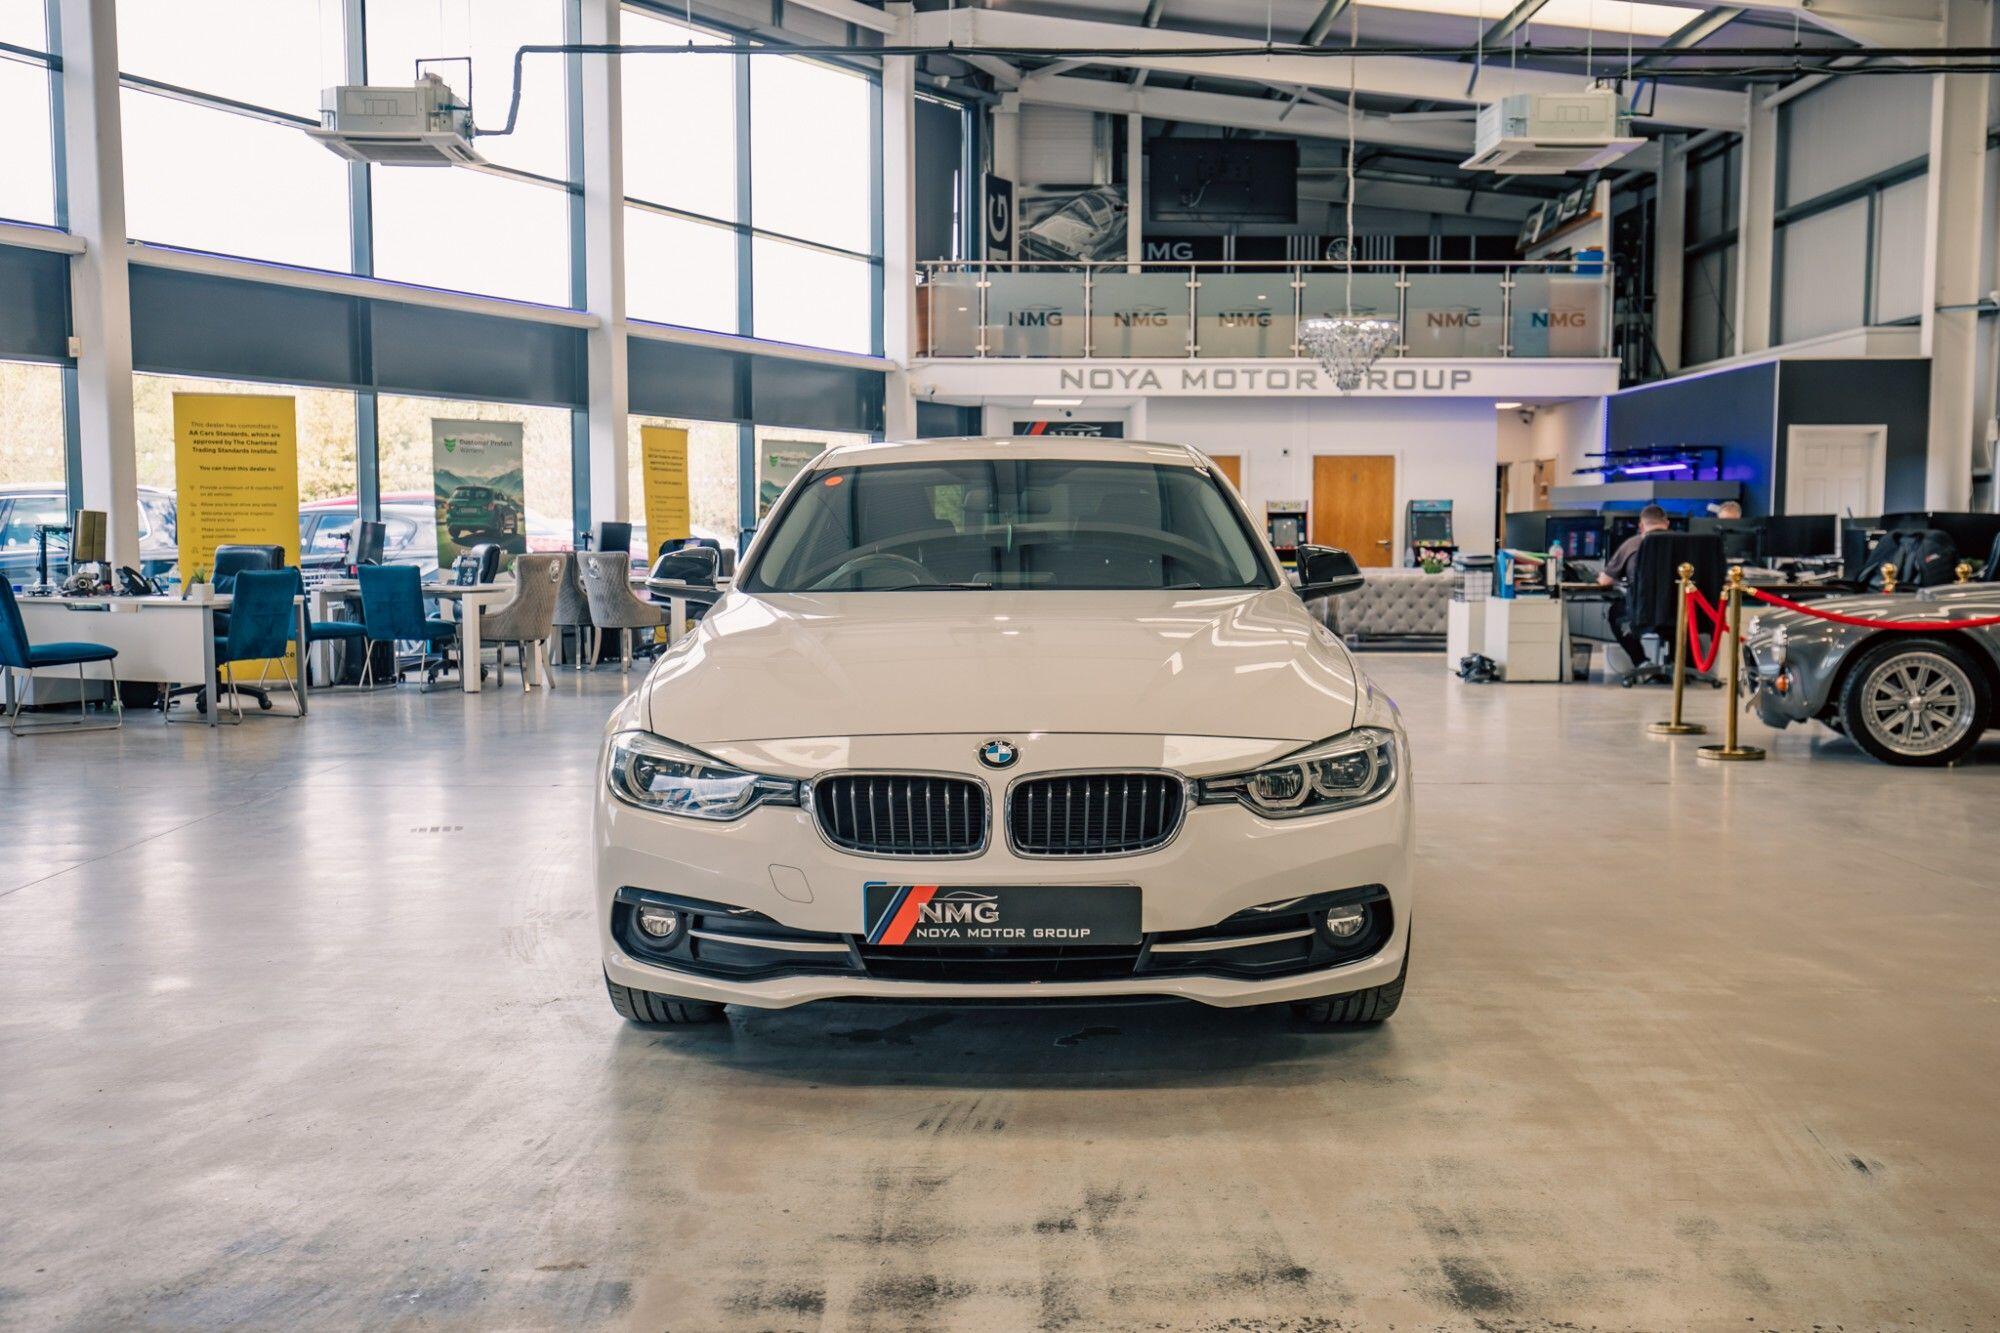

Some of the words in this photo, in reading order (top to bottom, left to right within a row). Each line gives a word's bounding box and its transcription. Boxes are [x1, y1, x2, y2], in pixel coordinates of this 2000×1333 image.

[1143, 242, 1193, 260] MG
[1008, 312, 1063, 327] NMG
[1113, 312, 1168, 327] NMG
[1218, 312, 1272, 327] NMG
[1427, 312, 1481, 327] NMG
[1531, 312, 1586, 328] NMG
[1060, 369, 1162, 389] NOYA
[1181, 369, 1318, 390] MOTOR
[917, 902, 1000, 924] NMG
[916, 928, 960, 938] NOYA
[967, 928, 1026, 938] MOTOR
[1033, 928, 1091, 938] GROUP
